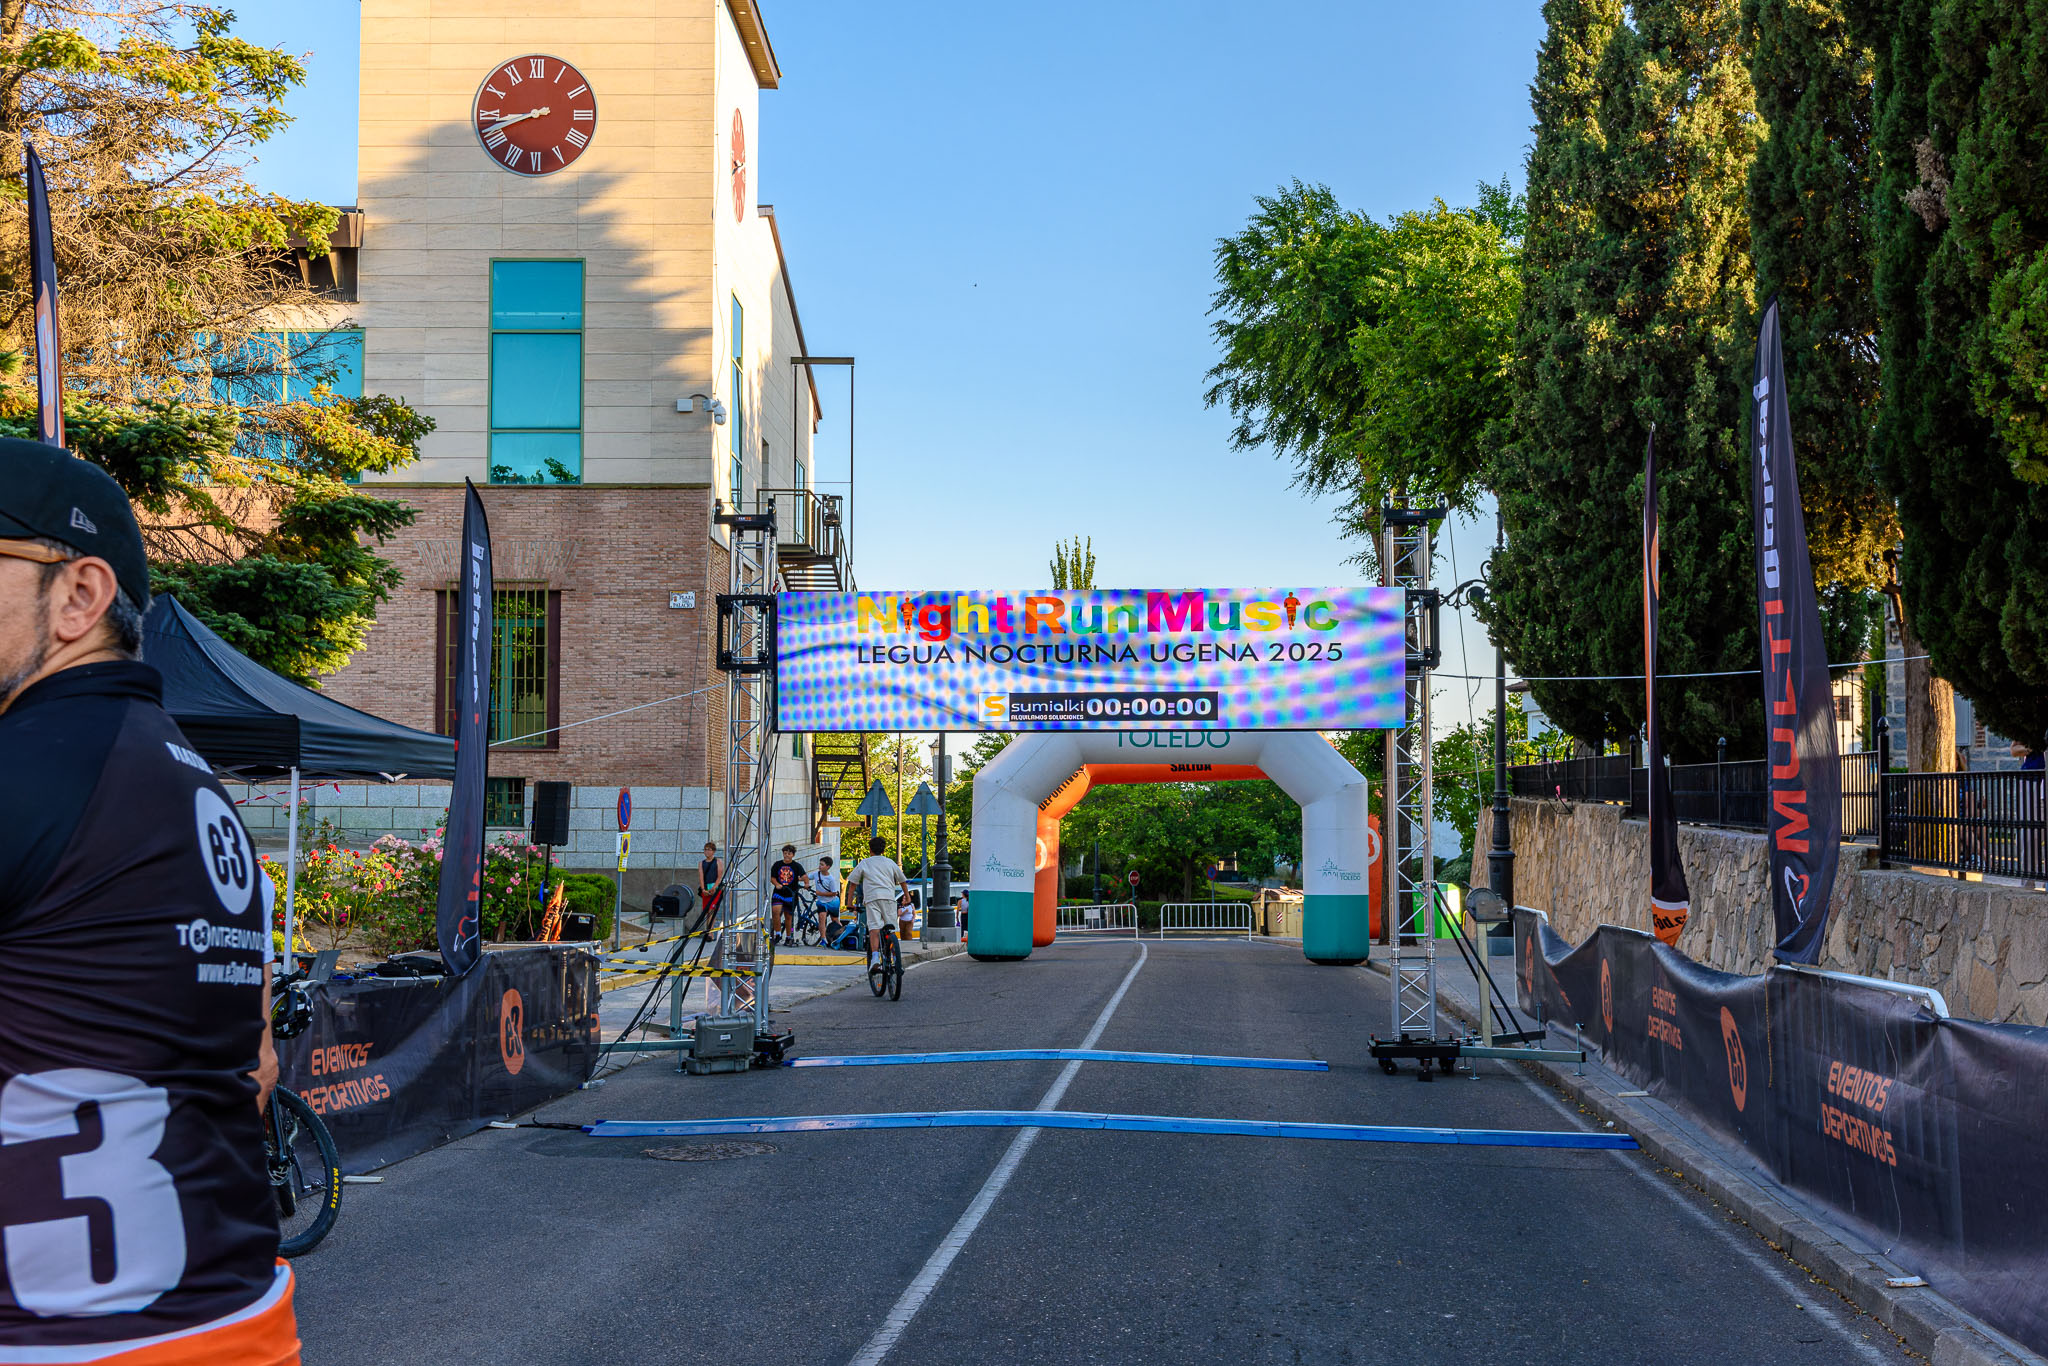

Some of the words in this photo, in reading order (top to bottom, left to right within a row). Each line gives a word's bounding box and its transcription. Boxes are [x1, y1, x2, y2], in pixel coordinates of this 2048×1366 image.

[529, 58, 545, 78] XII
[486, 84, 506, 99] X
[858, 645, 955, 664] LEGUA
[966, 644, 1139, 663] NOCTURNA
[1150, 643, 1259, 663] UGENA
[1269, 642, 1343, 662] 2025
[1011, 700, 1084, 712] sumialki
[1086, 698, 1212, 716] 00:00:00
[1652, 985, 1677, 1016] EVENTOS
[311, 1042, 375, 1076] EVENTOS
[1827, 1060, 1893, 1112] EVENTOS
[1821, 1103, 1897, 1167] DEPORTIVOS
[330, 1167, 339, 1209] MAXXIS
